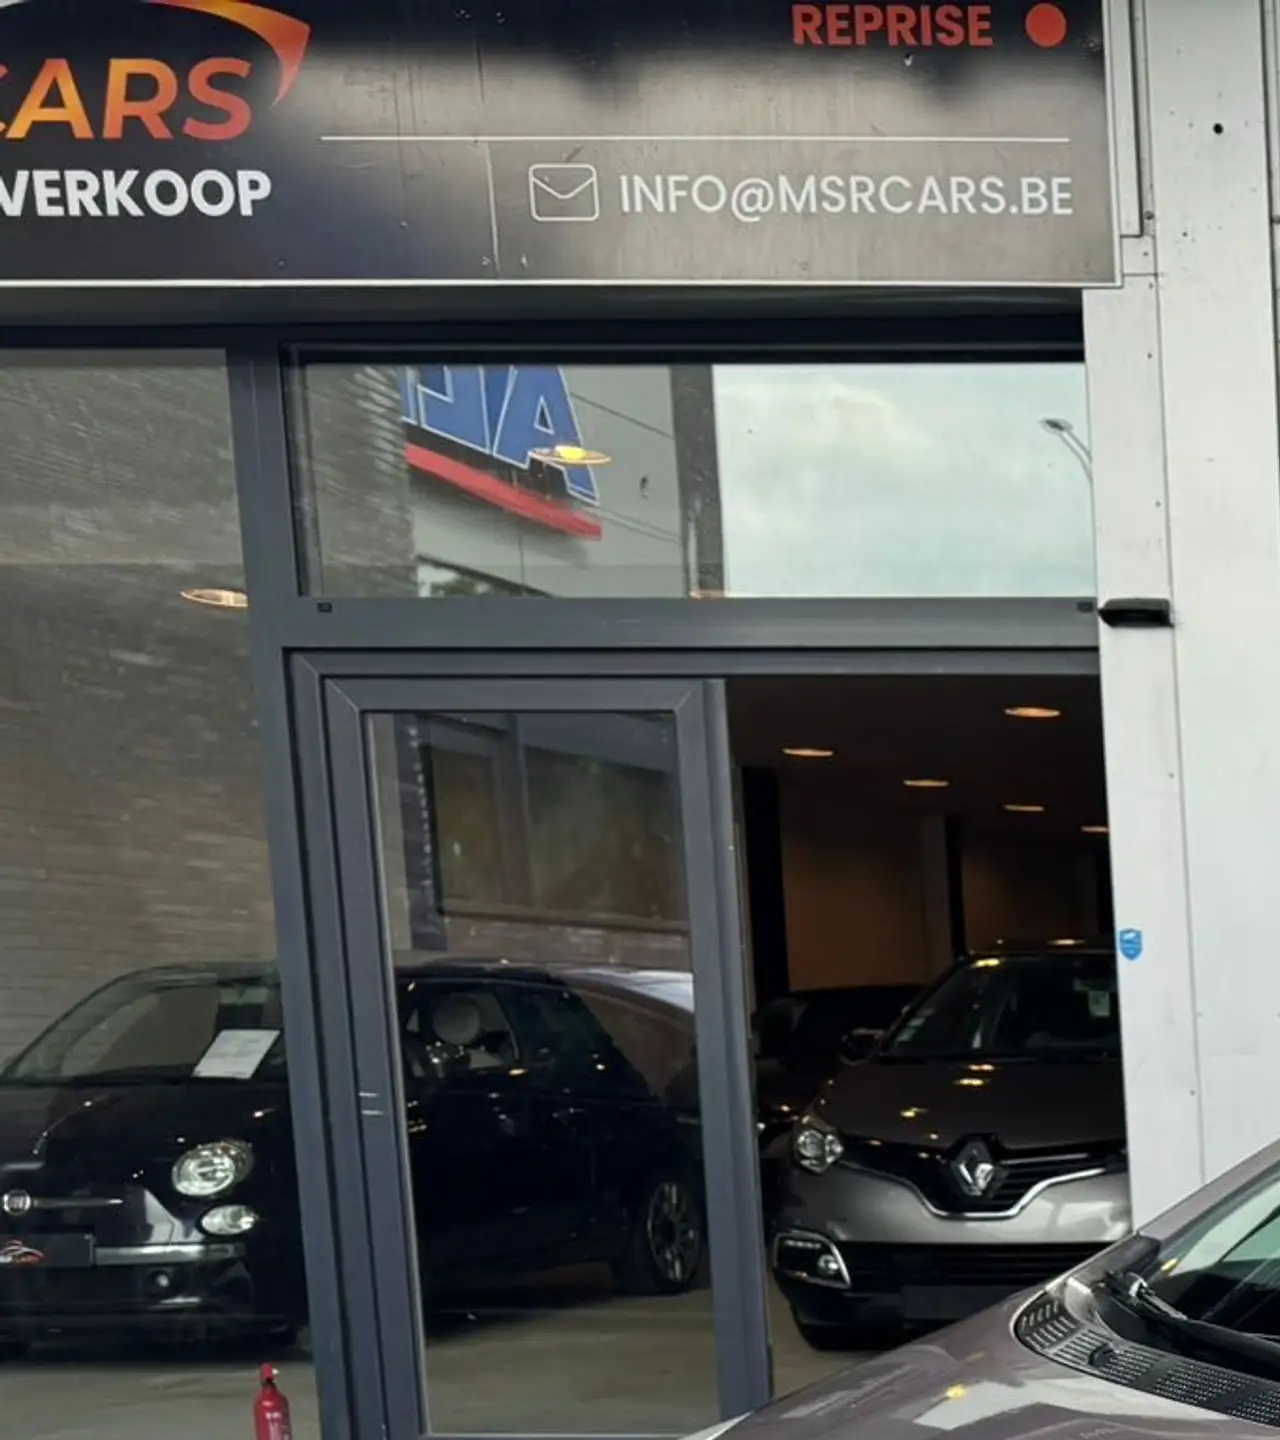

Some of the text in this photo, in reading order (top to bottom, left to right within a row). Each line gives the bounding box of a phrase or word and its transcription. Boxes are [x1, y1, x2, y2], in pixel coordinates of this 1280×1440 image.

[791, 4, 994, 47] REPRISE
[0, 57, 252, 141] ARS
[619, 174, 1074, 222] INFO@MSRCARS.BE
